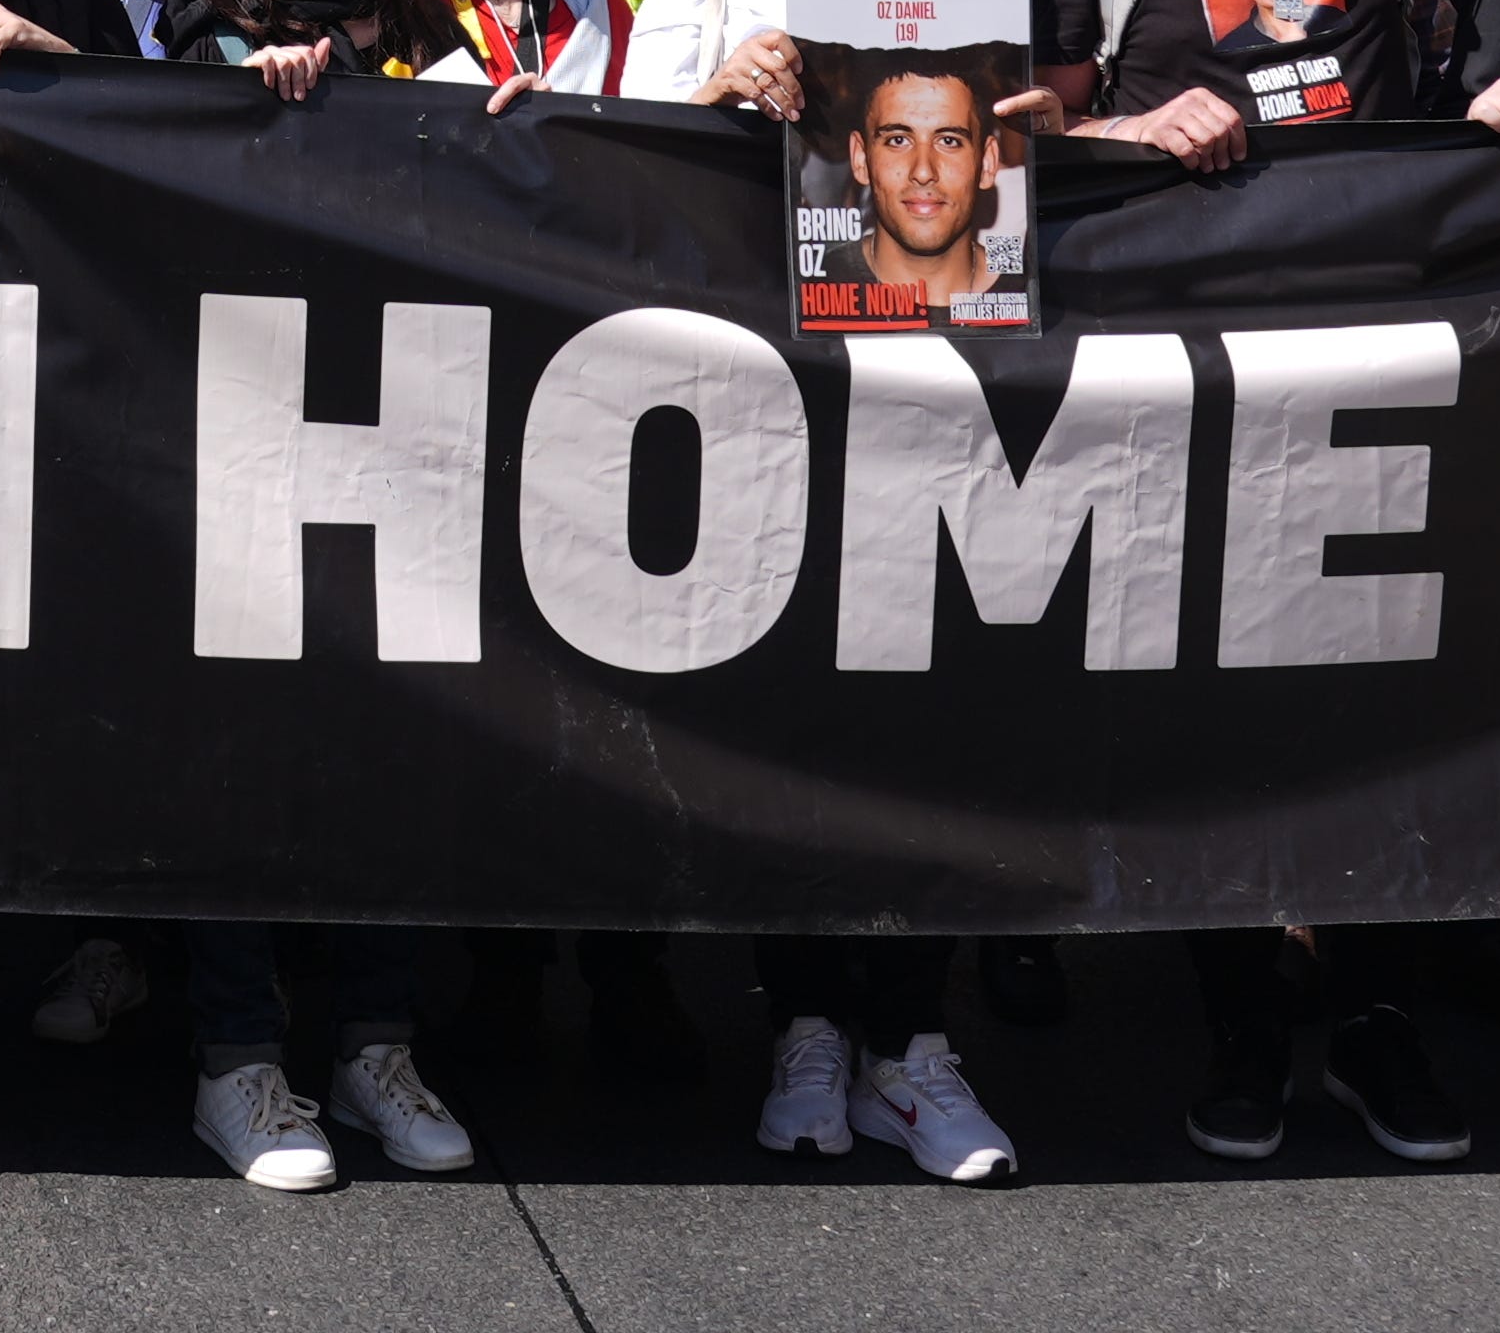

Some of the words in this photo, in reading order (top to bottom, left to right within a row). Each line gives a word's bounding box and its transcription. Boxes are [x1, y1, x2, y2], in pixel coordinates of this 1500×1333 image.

[877, 1, 893, 20] OZ
[896, 1, 937, 20] DANIEL
[895, 22, 919, 43] (19)
[1246, 64, 1299, 94] BRING
[1299, 55, 1343, 84] OMER
[1255, 91, 1307, 122] HOME
[1303, 81, 1352, 112] NOW!
[796, 207, 862, 242] BRING
[799, 243, 827, 278] OZ
[801, 283, 860, 317] HOME
[864, 278, 928, 317] NOW!
[949, 302, 994, 320] FAMILIES
[994, 302, 1029, 320] FORUM
[193, 290, 1463, 675] HOME
